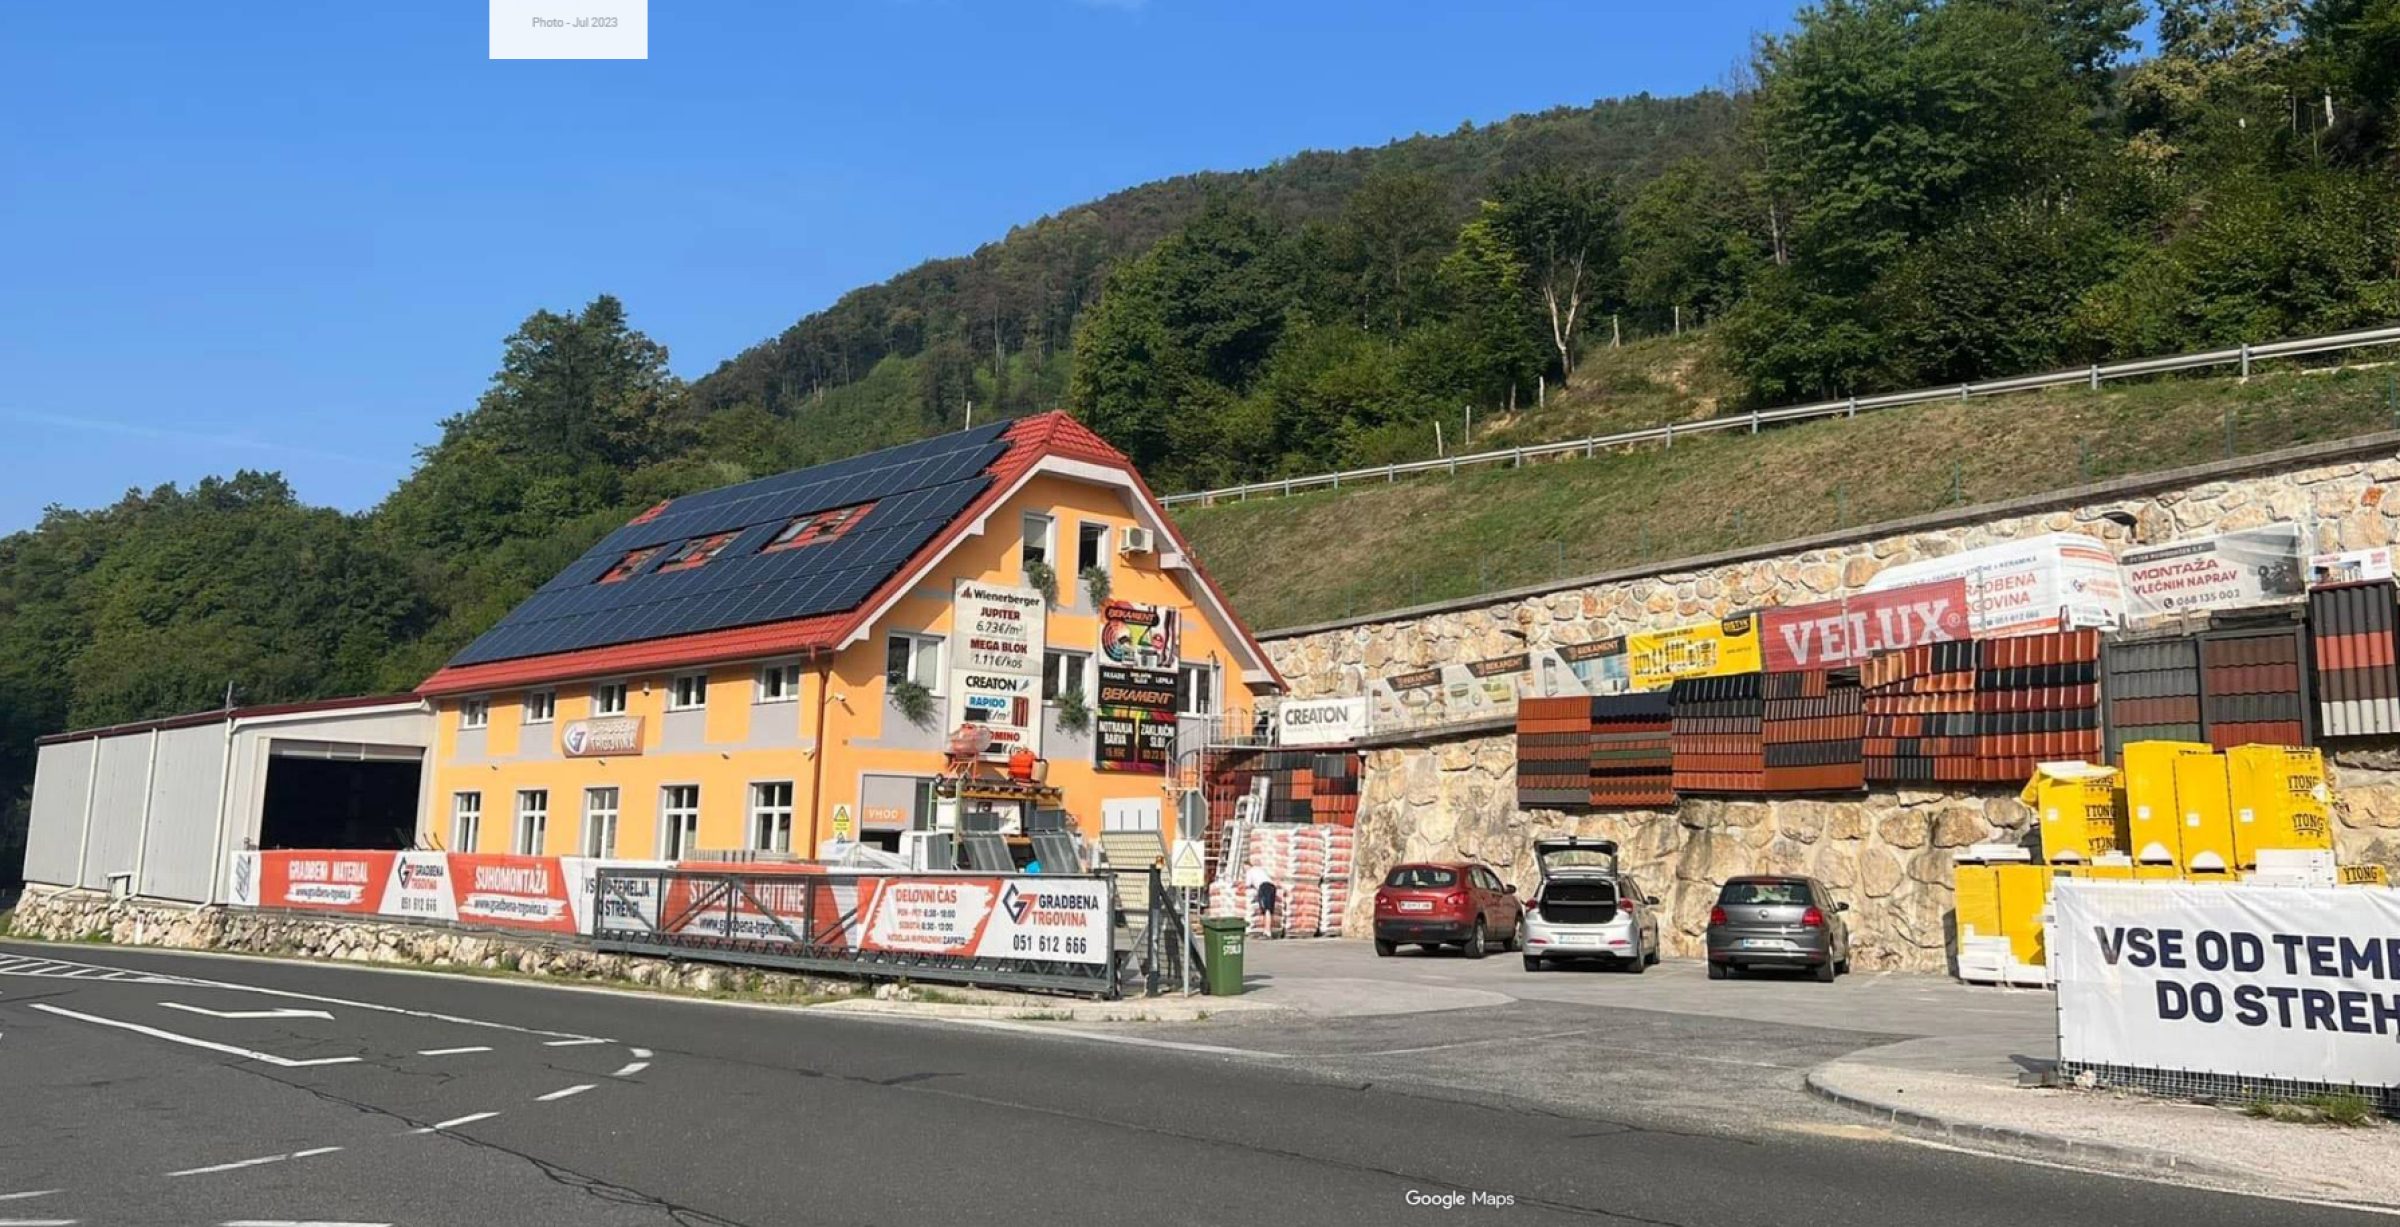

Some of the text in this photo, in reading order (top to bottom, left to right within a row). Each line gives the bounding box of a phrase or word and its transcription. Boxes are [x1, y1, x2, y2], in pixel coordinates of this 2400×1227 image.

[2132, 558, 2219, 581] MONTAŽA
[2133, 580, 2184, 595] VLEČNIH
[2187, 570, 2237, 588] NAPRAV
[974, 588, 1040, 607] Wienerberger
[2199, 593, 2217, 602] 135
[980, 607, 1021, 620] JUPITER
[970, 639, 1028, 654] MEGA BLOK
[965, 676, 1017, 691] CREATON
[969, 696, 1006, 708] RAPIDO
[1102, 687, 1175, 704] BEKAMENT
[1285, 705, 1348, 726] CREATON
[475, 863, 548, 895] SUHOMONTAŽA
[2343, 866, 2378, 881] YTONG
[585, 876, 596, 894] VS
[895, 886, 957, 904] DELOVNI ČAS
[1038, 894, 1099, 910] GRADBENA
[1032, 911, 1087, 928] TRGOVINA
[1013, 934, 1087, 954] 051 612 666
[2094, 925, 2187, 969] VSE
[2196, 930, 2264, 973] OD
[2155, 980, 2223, 1023] DO
